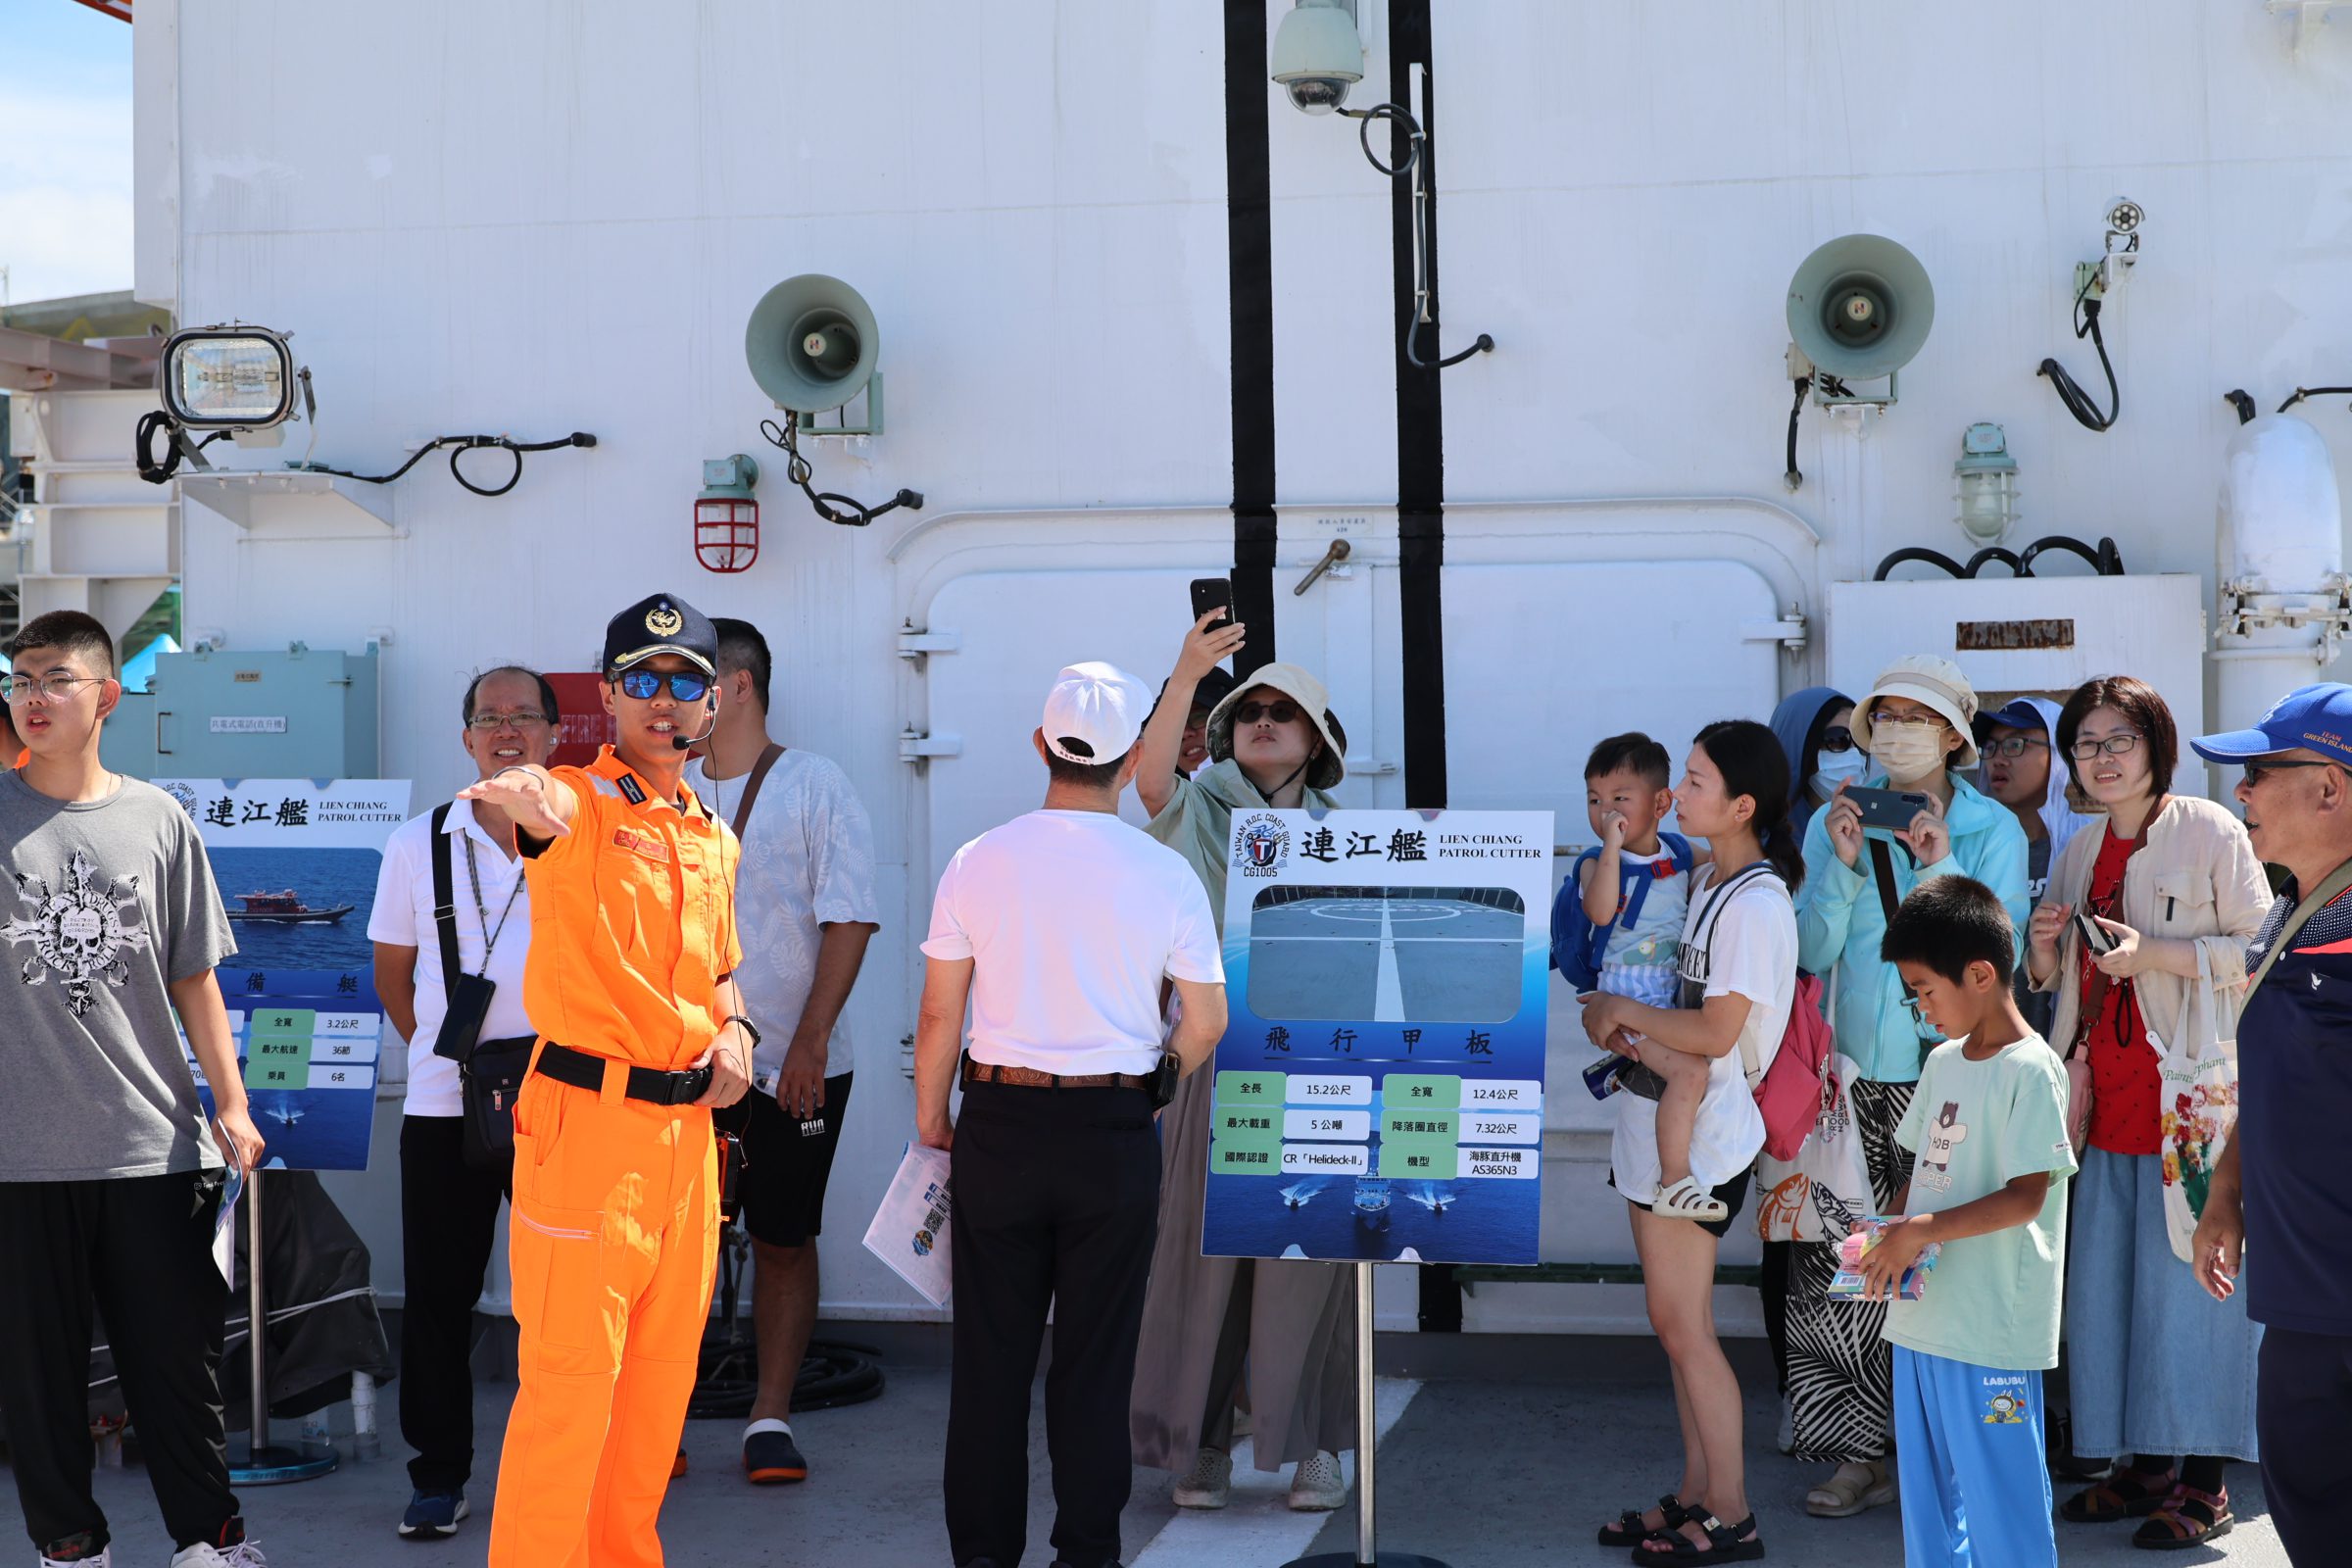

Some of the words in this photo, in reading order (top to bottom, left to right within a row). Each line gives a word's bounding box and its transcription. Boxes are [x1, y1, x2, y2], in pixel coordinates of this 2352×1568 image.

[562, 714, 601, 743] FIRE
[2303, 732, 2328, 745] GREEN
[319, 801, 343, 809] LIEN
[346, 802, 387, 810] CHIANG
[204, 796, 309, 827] 連江艦
[318, 813, 358, 822] PATROL
[361, 813, 402, 822] CUTTER
[1235, 825, 1248, 858] TAIWAN
[1265, 812, 1286, 829] COAST
[1280, 831, 1291, 858] GUARD
[1440, 834, 1469, 844] LIEN
[1472, 835, 1523, 845] CHIANG
[1299, 826, 1428, 862] 連江艦
[1439, 849, 1488, 858] PATROL
[1490, 849, 1542, 858] CUTTER
[1244, 866, 1278, 878] CG1005
[89, 894, 120, 928] DRUGS
[38, 938, 72, 971] ROCK
[88, 943, 118, 970] ROLL
[274, 1017, 293, 1027] 全寬
[327, 1019, 359, 1029] 3.2公尺
[262, 1044, 299, 1054] 最大航速
[332, 1046, 351, 1055] 36節
[268, 1071, 286, 1081] 乘員
[331, 1073, 345, 1082] 6名
[1240, 1083, 1262, 1094] 全長
[1306, 1085, 1351, 1096] 15.2公尺
[1411, 1087, 1433, 1098] 全寬
[1473, 1089, 1518, 1100] 12.4公尺
[801, 1118, 825, 1135] RUN
[1227, 1117, 1271, 1129] 最大載重
[1392, 1121, 1448, 1133] 降落圈直徑
[1475, 1123, 1517, 1134] 7.32公尺
[1225, 1152, 1269, 1163] 國際認證
[1284, 1153, 1297, 1163] CR
[1407, 1156, 1430, 1167] 機型
[1469, 1151, 1522, 1162] 海豚直升機
[1472, 1165, 1517, 1175] AS365N3
[1983, 1376, 2026, 1386] LABUBU
